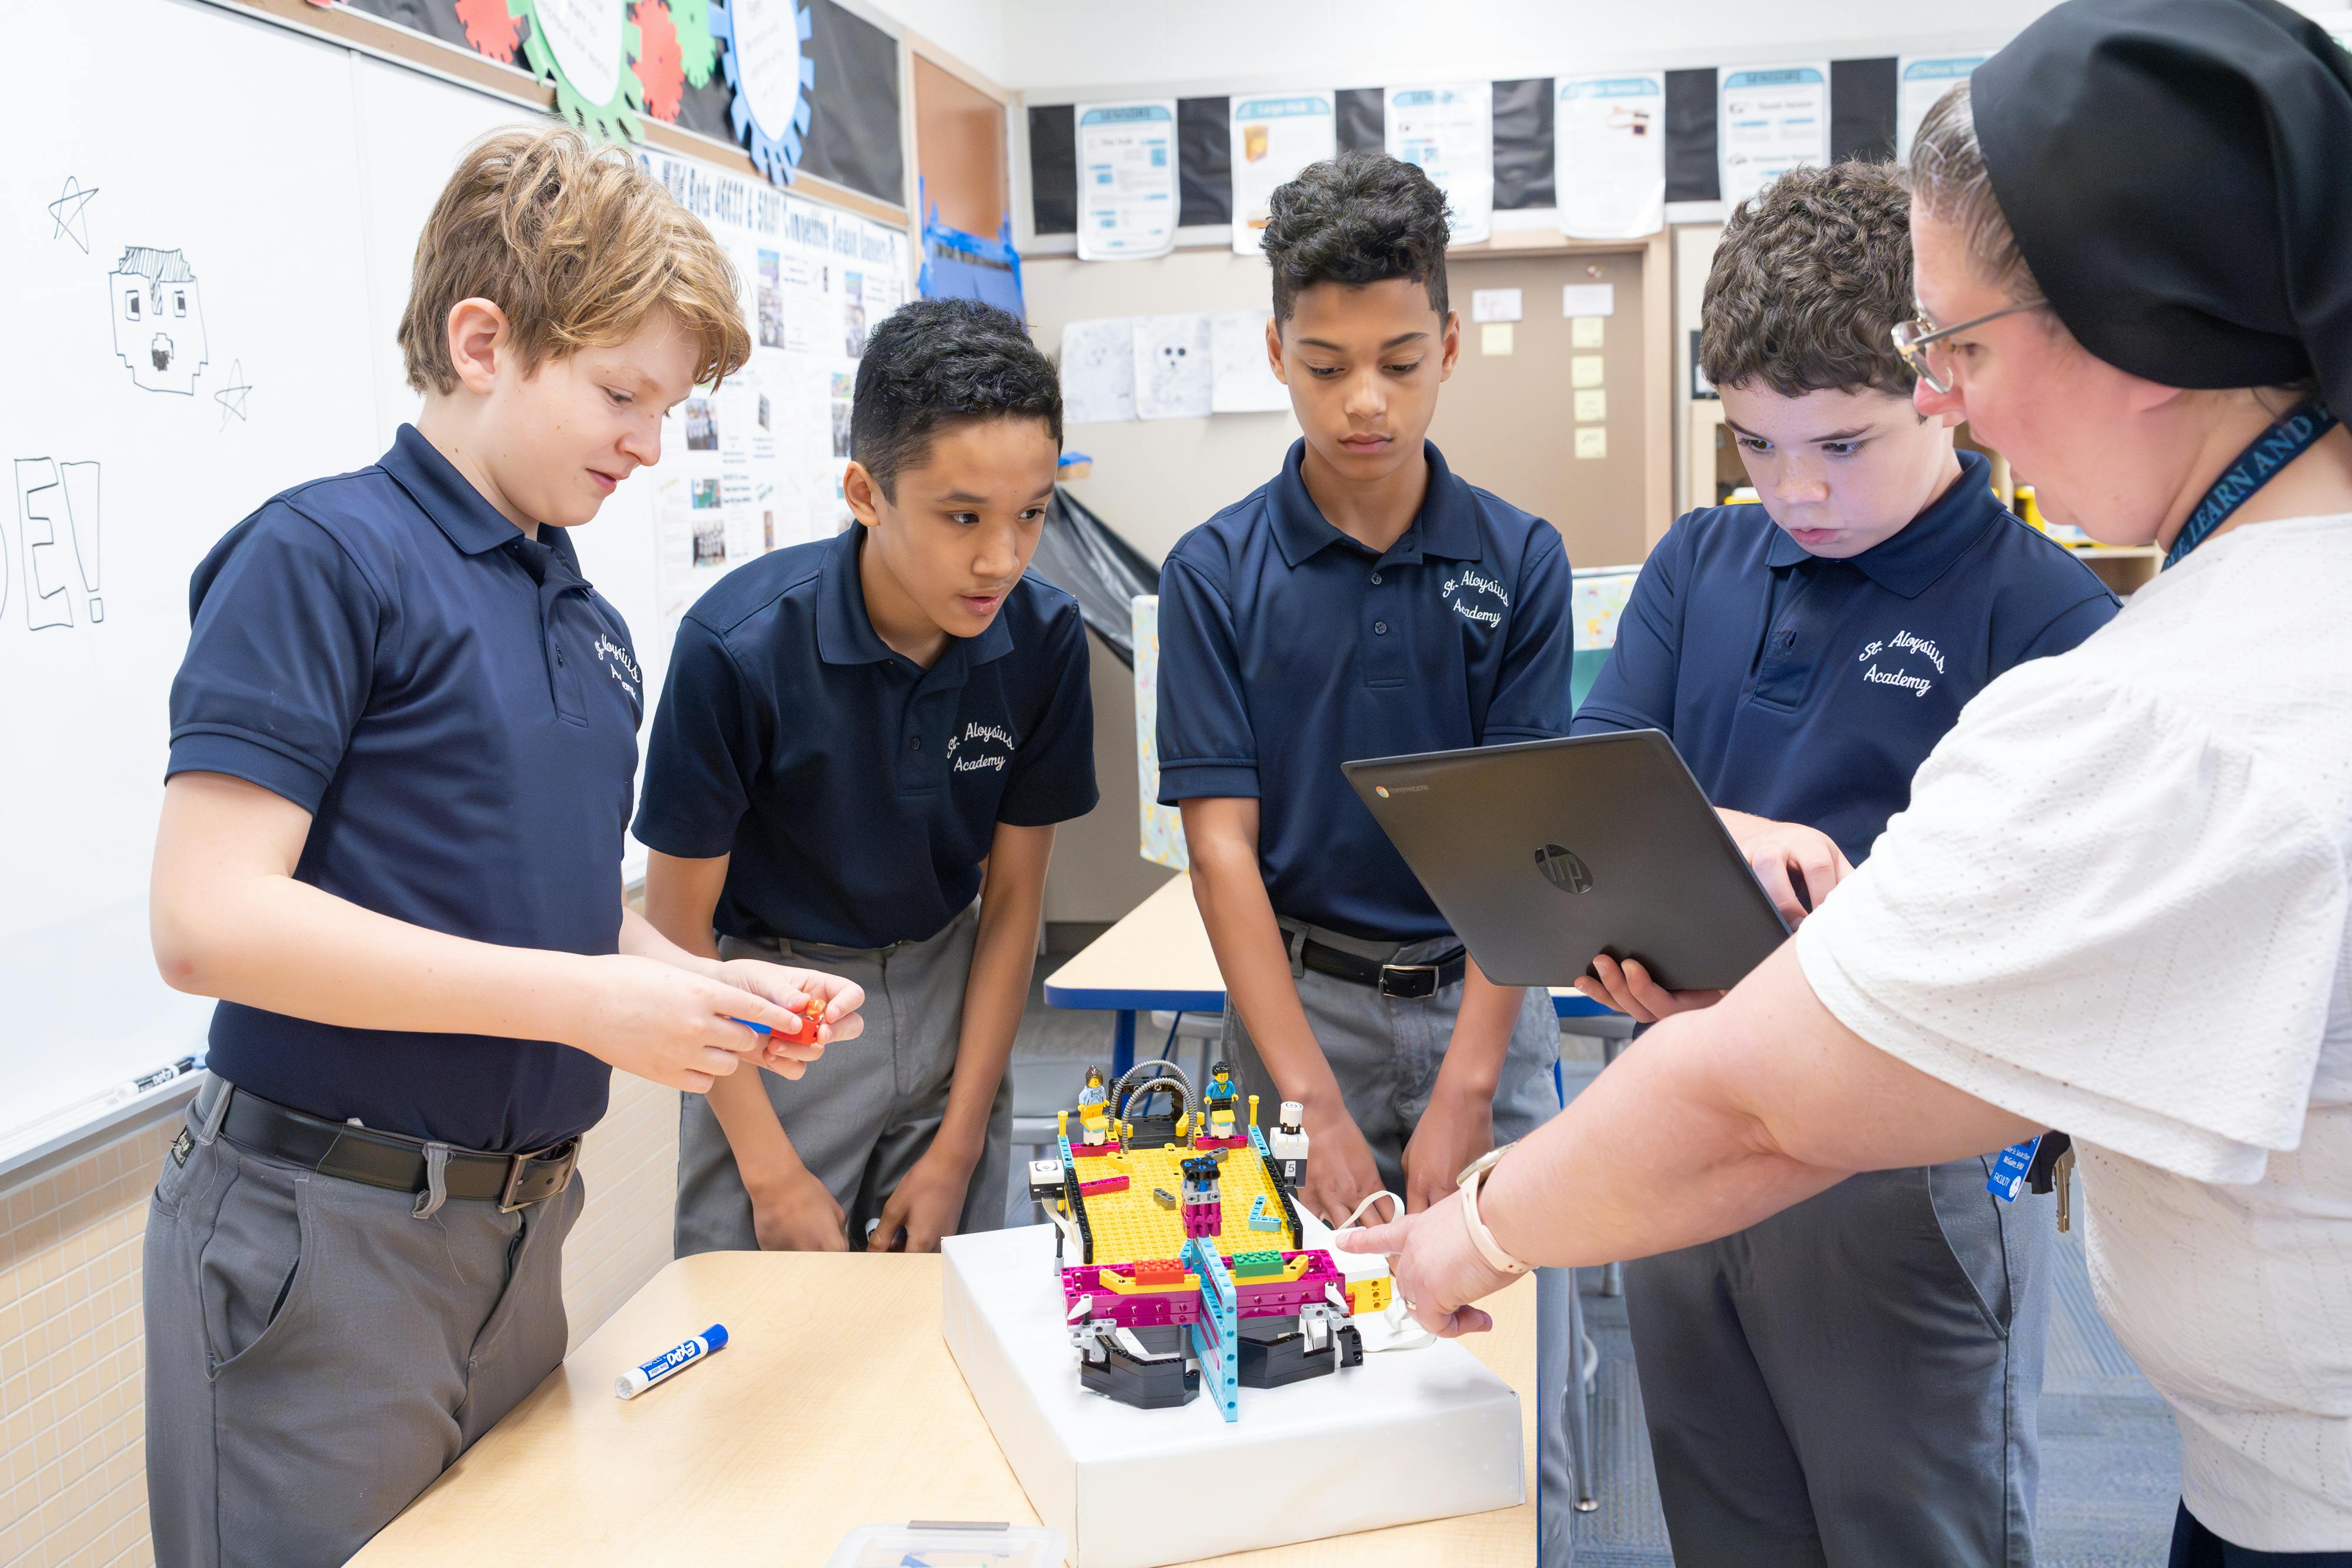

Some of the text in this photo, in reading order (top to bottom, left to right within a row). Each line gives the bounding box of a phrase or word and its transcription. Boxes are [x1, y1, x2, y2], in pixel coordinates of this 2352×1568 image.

[2188, 414, 2313, 543] LEARN AND
[1442, 570, 1509, 607] St. Aloysius
[1453, 598, 1501, 628] Academy
[1859, 630, 1945, 674] St. Aloysius
[1863, 664, 1932, 697] Academy
[947, 721, 1015, 759] St. Aloysius
[954, 754, 1005, 771] Academy
[1288, 1164, 1295, 1172] 5
[1993, 1172, 2011, 1187] FACULTY
